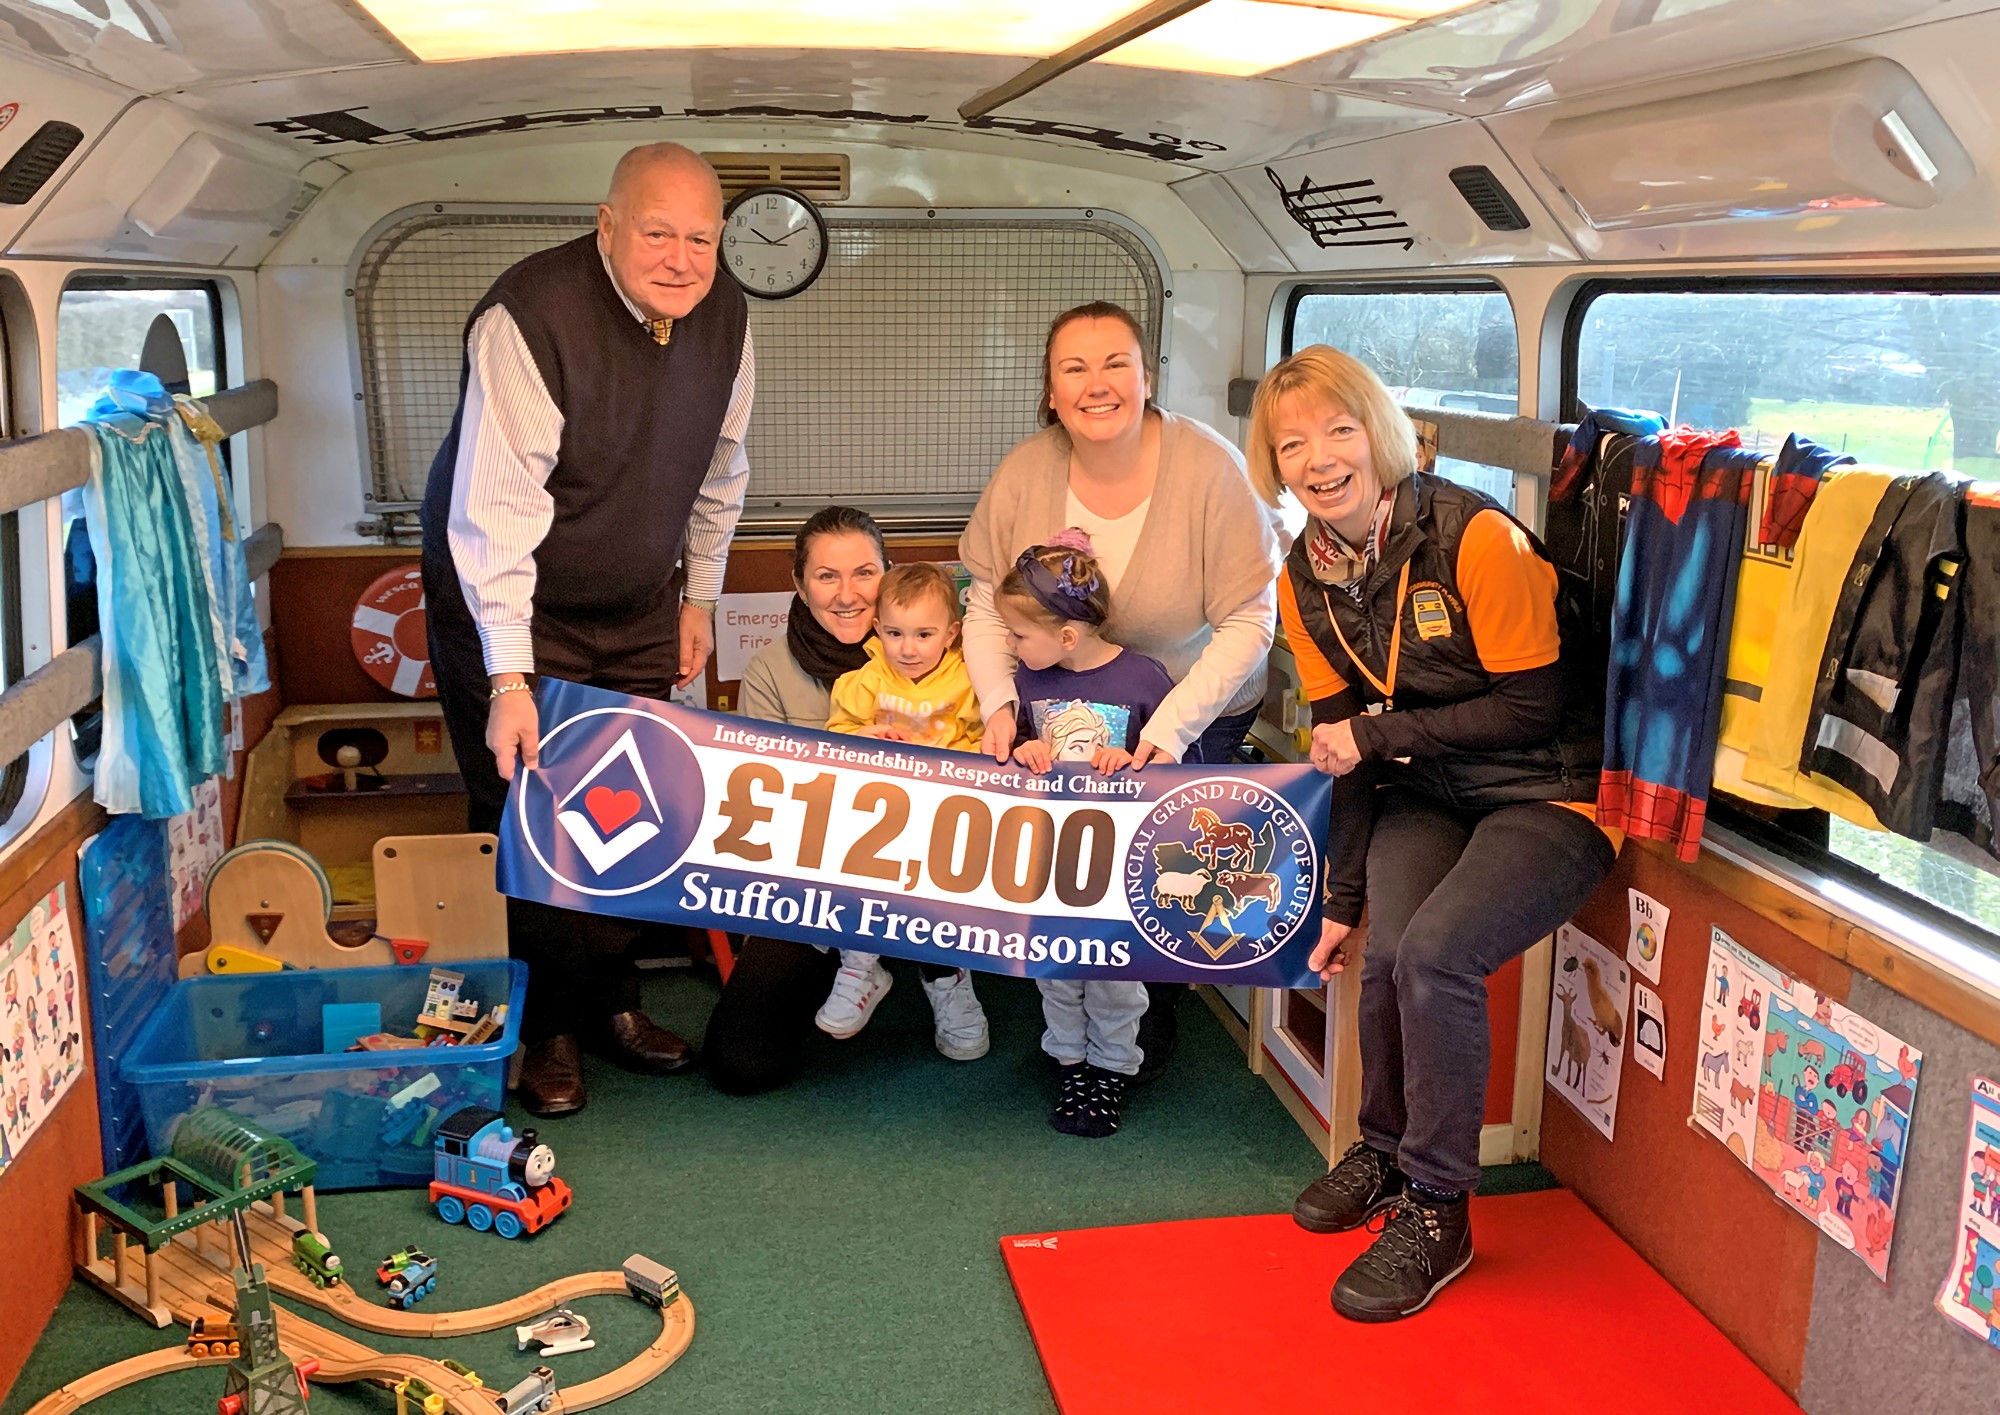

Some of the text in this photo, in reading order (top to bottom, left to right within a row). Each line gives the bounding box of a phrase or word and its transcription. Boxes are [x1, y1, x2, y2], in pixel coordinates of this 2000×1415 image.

[750, 203, 759, 215] 11
[765, 197, 777, 210] 12
[735, 215, 747, 227] 10
[801, 218, 809, 230] 2
[728, 235, 737, 247] 9
[808, 238, 815, 250] 3
[735, 254, 743, 266] 8
[800, 258, 808, 270] 4
[749, 268, 756, 280] 7
[767, 273, 775, 286] 6
[786, 270, 794, 283] 5
[726, 610, 788, 629] Emerge
[712, 724, 1146, 799] Integrity, Friendship, Respect and Charity
[713, 761, 1116, 908] £12,000
[1127, 784, 1312, 957] PROVINCIAL GRAND LODGE OF SUFFOLK
[1635, 896, 1653, 919] Bb
[678, 871, 1131, 967] Suffolk Freemasons
[470, 1169, 477, 1184] 1
